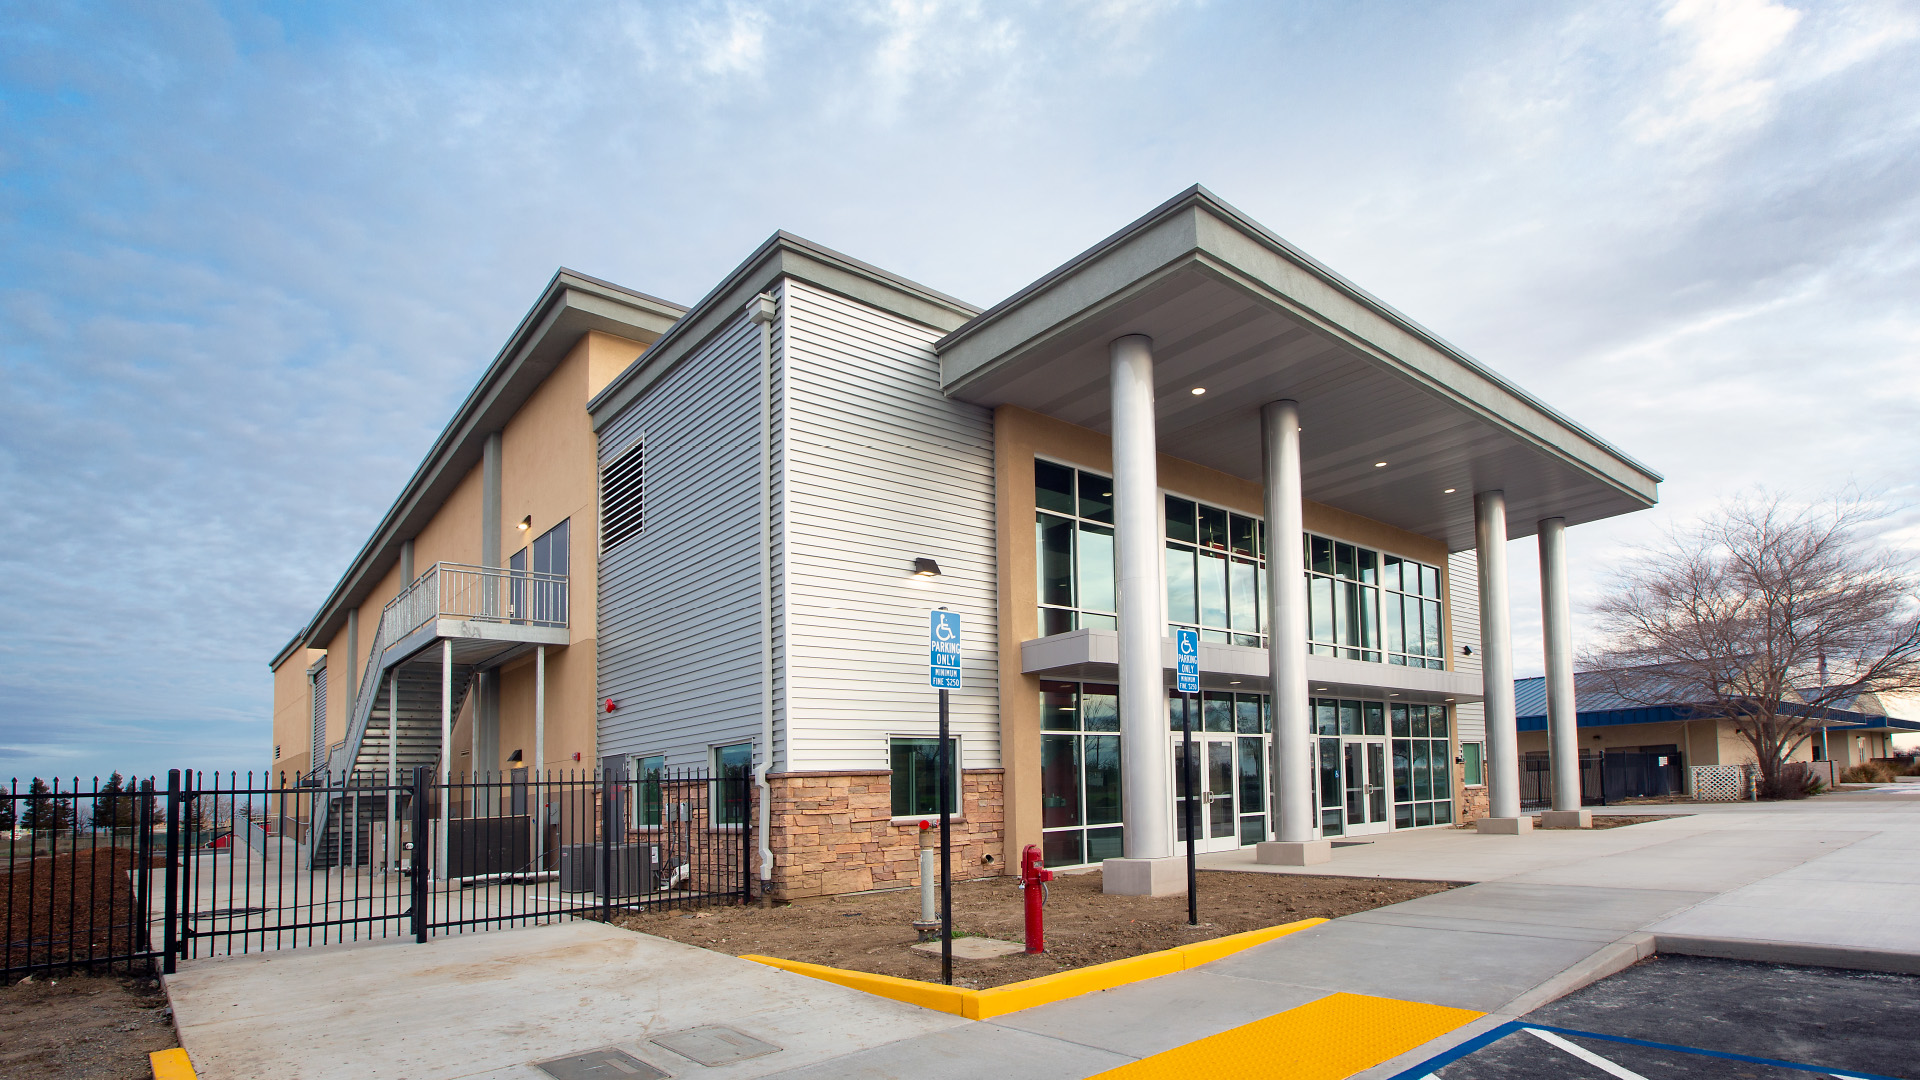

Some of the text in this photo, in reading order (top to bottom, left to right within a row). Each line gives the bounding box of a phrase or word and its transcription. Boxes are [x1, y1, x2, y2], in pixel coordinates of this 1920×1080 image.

[932, 641, 960, 654] PARKING
[937, 654, 955, 665] ONLY
[1178, 654, 1198, 664] PARKING
[935, 668, 957, 677] MINIMUM
[1182, 664, 1194, 674] ONLY
[933, 678, 959, 686] FINE $250
